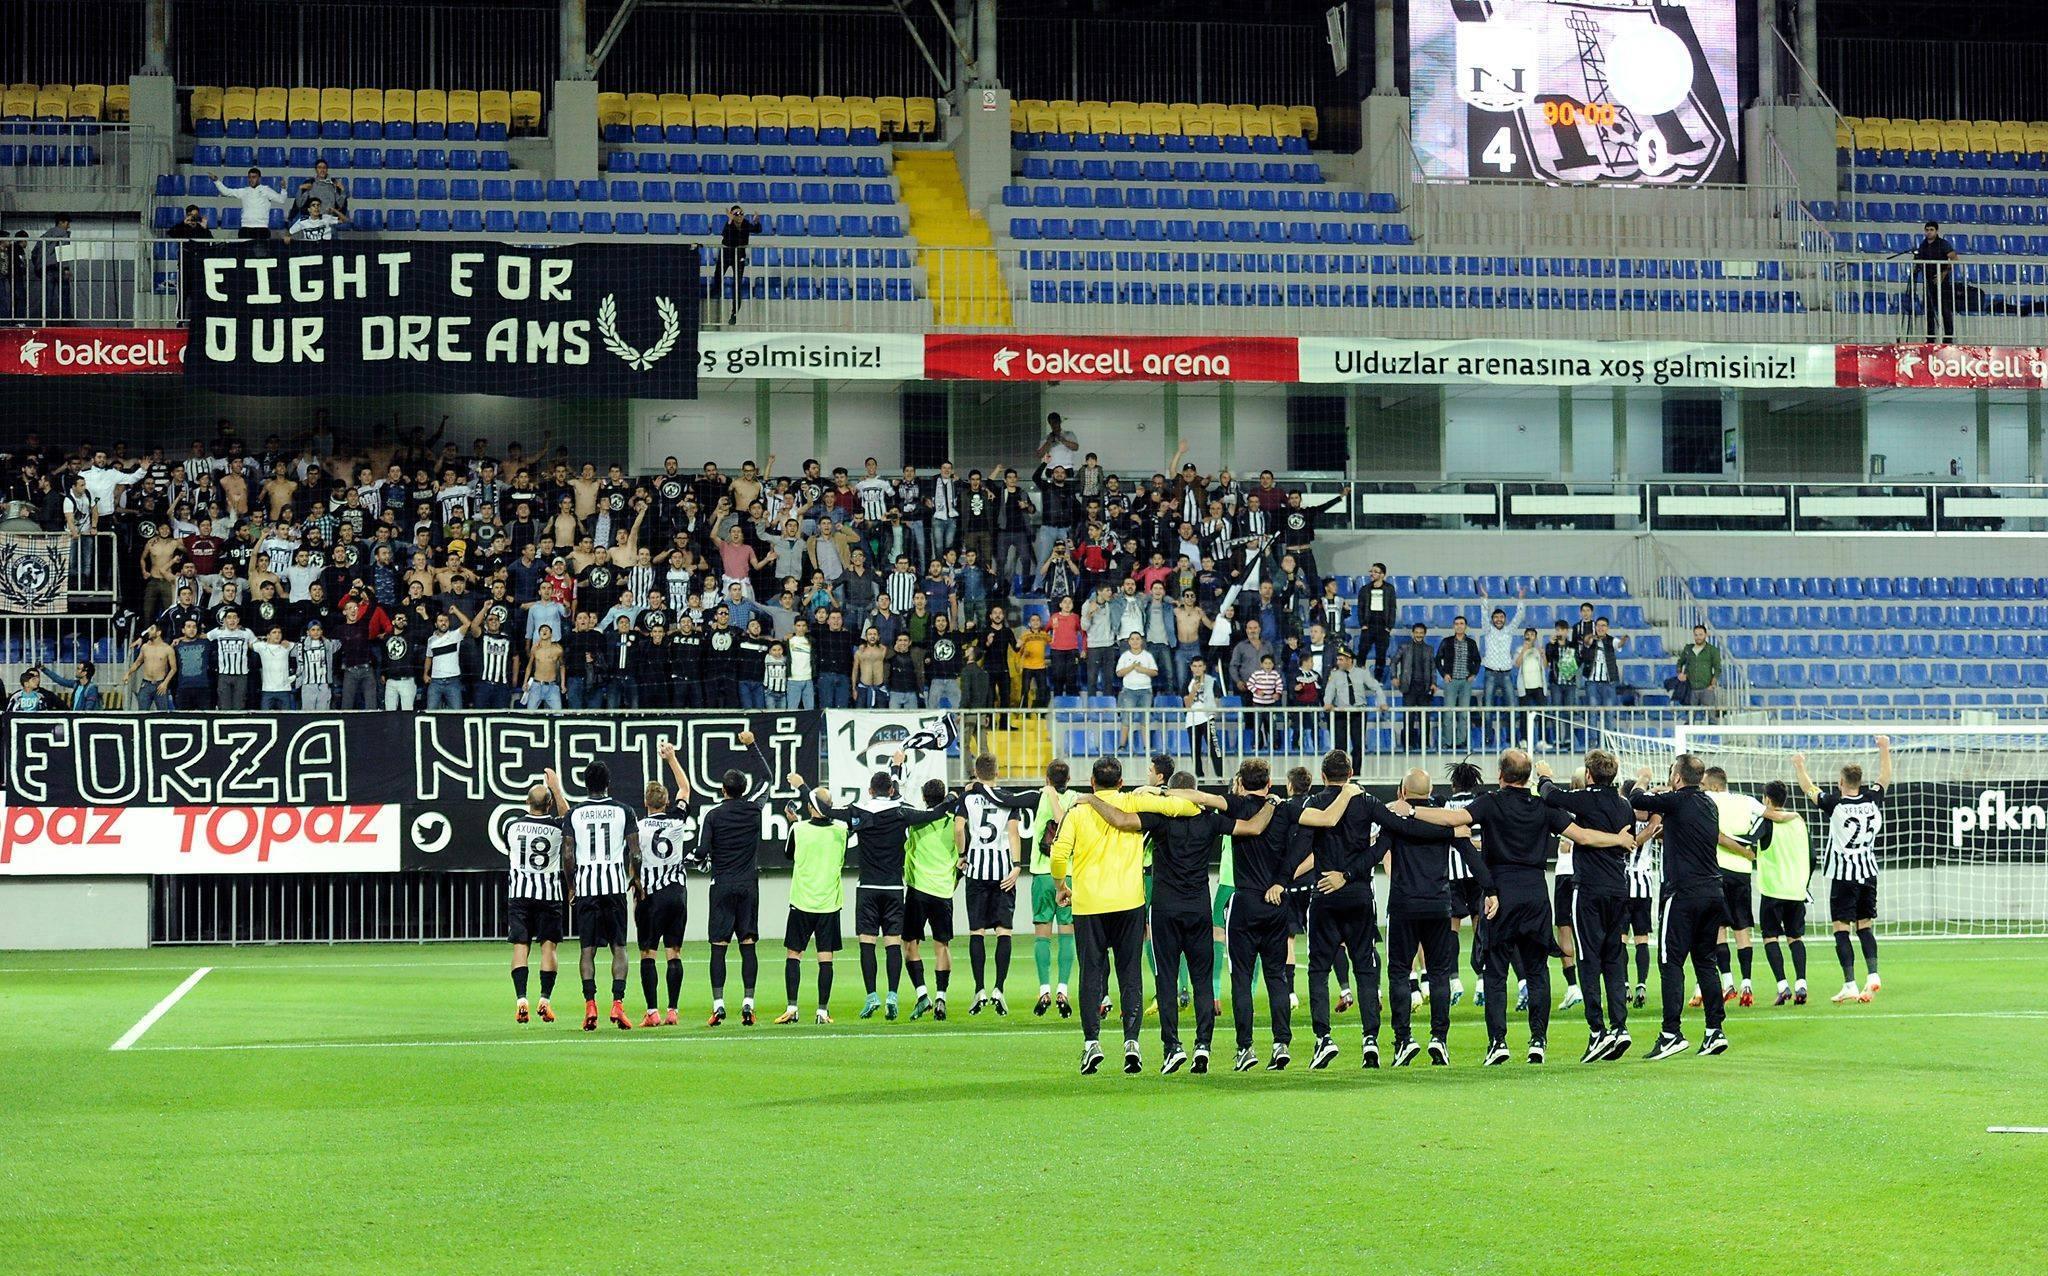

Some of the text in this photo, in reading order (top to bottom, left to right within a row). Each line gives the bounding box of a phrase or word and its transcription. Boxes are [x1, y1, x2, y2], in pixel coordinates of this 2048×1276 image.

[1542, 102, 1615, 126] 90:00
[1482, 127, 1516, 173] 4
[1637, 129, 1668, 176] 0
[55, 339, 168, 366] bakcell
[205, 317, 324, 363] OUR
[362, 316, 590, 365] DREAMS
[727, 344, 881, 374] gəlmisiniz!
[1027, 348, 1231, 376] bakcell arena
[1335, 350, 1797, 385] Ulduzlar arenasına xoş gəlmisiniz!
[1928, 355, 2022, 378] bakcell
[516, 824, 555, 836] AXUNDOV
[979, 808, 998, 844] 5
[1843, 814, 1876, 849] 25
[1952, 790, 2046, 847] pfkn
[517, 834, 552, 871] 18
[586, 823, 611, 861] 11
[652, 828, 673, 859] 6
